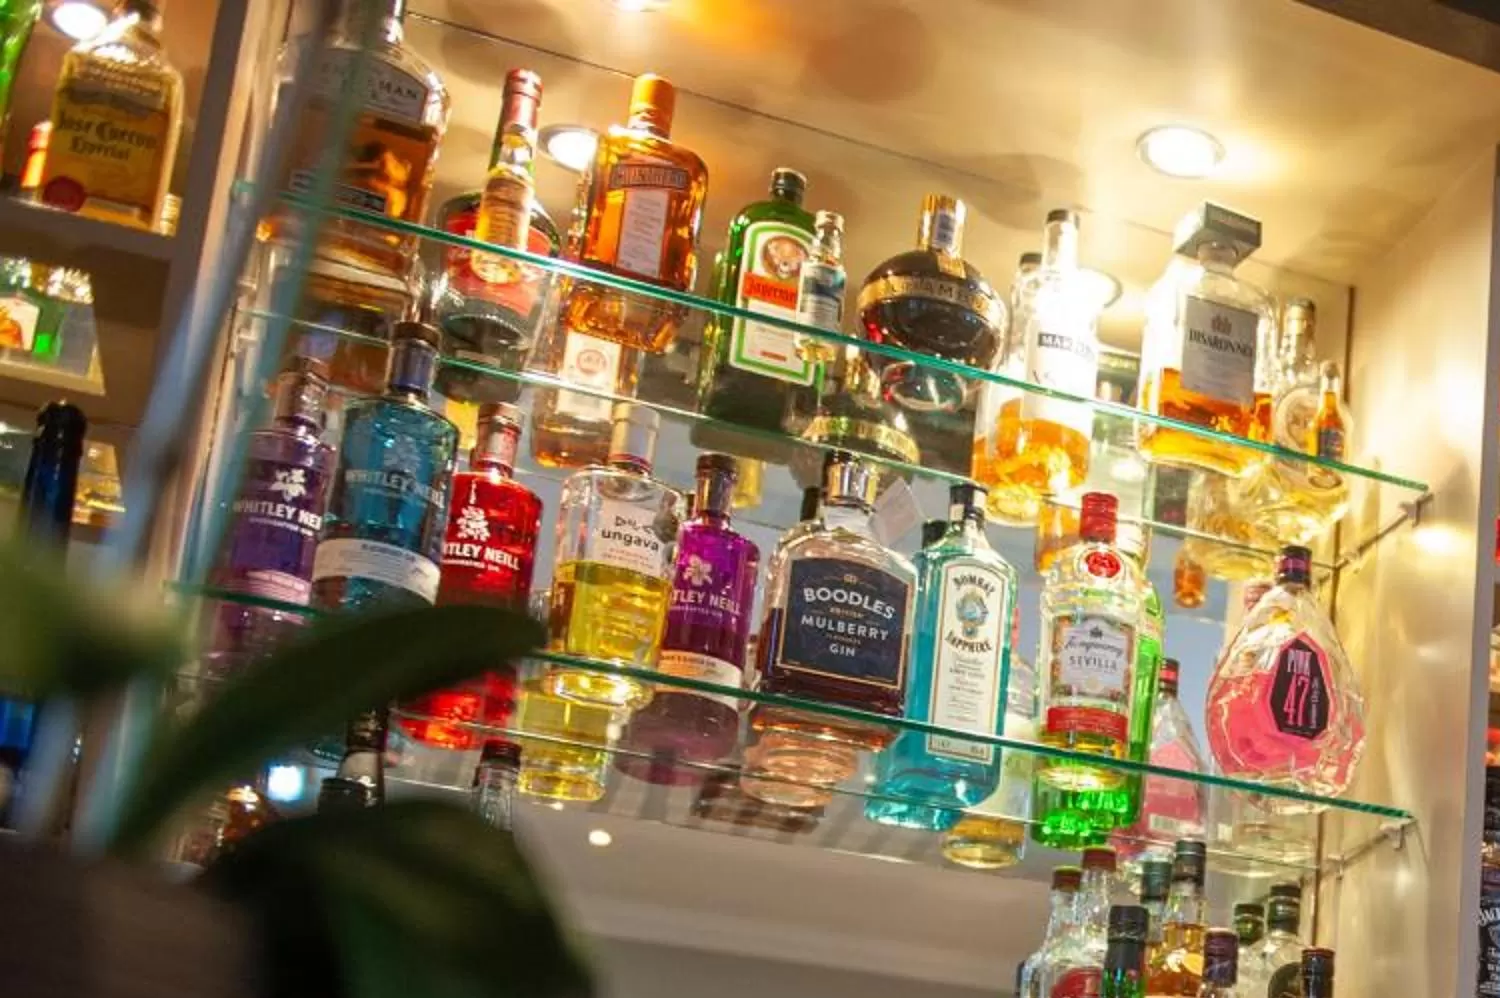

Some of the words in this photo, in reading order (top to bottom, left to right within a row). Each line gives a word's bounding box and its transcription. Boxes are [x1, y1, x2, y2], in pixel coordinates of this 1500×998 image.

[298, 511, 322, 531] NEI
[601, 528, 660, 552] ungava
[443, 541, 479, 557] ITLEY
[484, 547, 520, 571] NEILL
[952, 572, 996, 596] BOMBAY
[709, 597, 740, 616] NEILL
[803, 587, 896, 620] BOODLES
[801, 614, 889, 641] MULBERRY
[829, 643, 855, 657] GIN
[945, 630, 992, 653] SAPPHIRE
[1069, 654, 1118, 671] SEVILLA
[1287, 648, 1312, 675] PINK
[1283, 673, 1310, 726] 47
